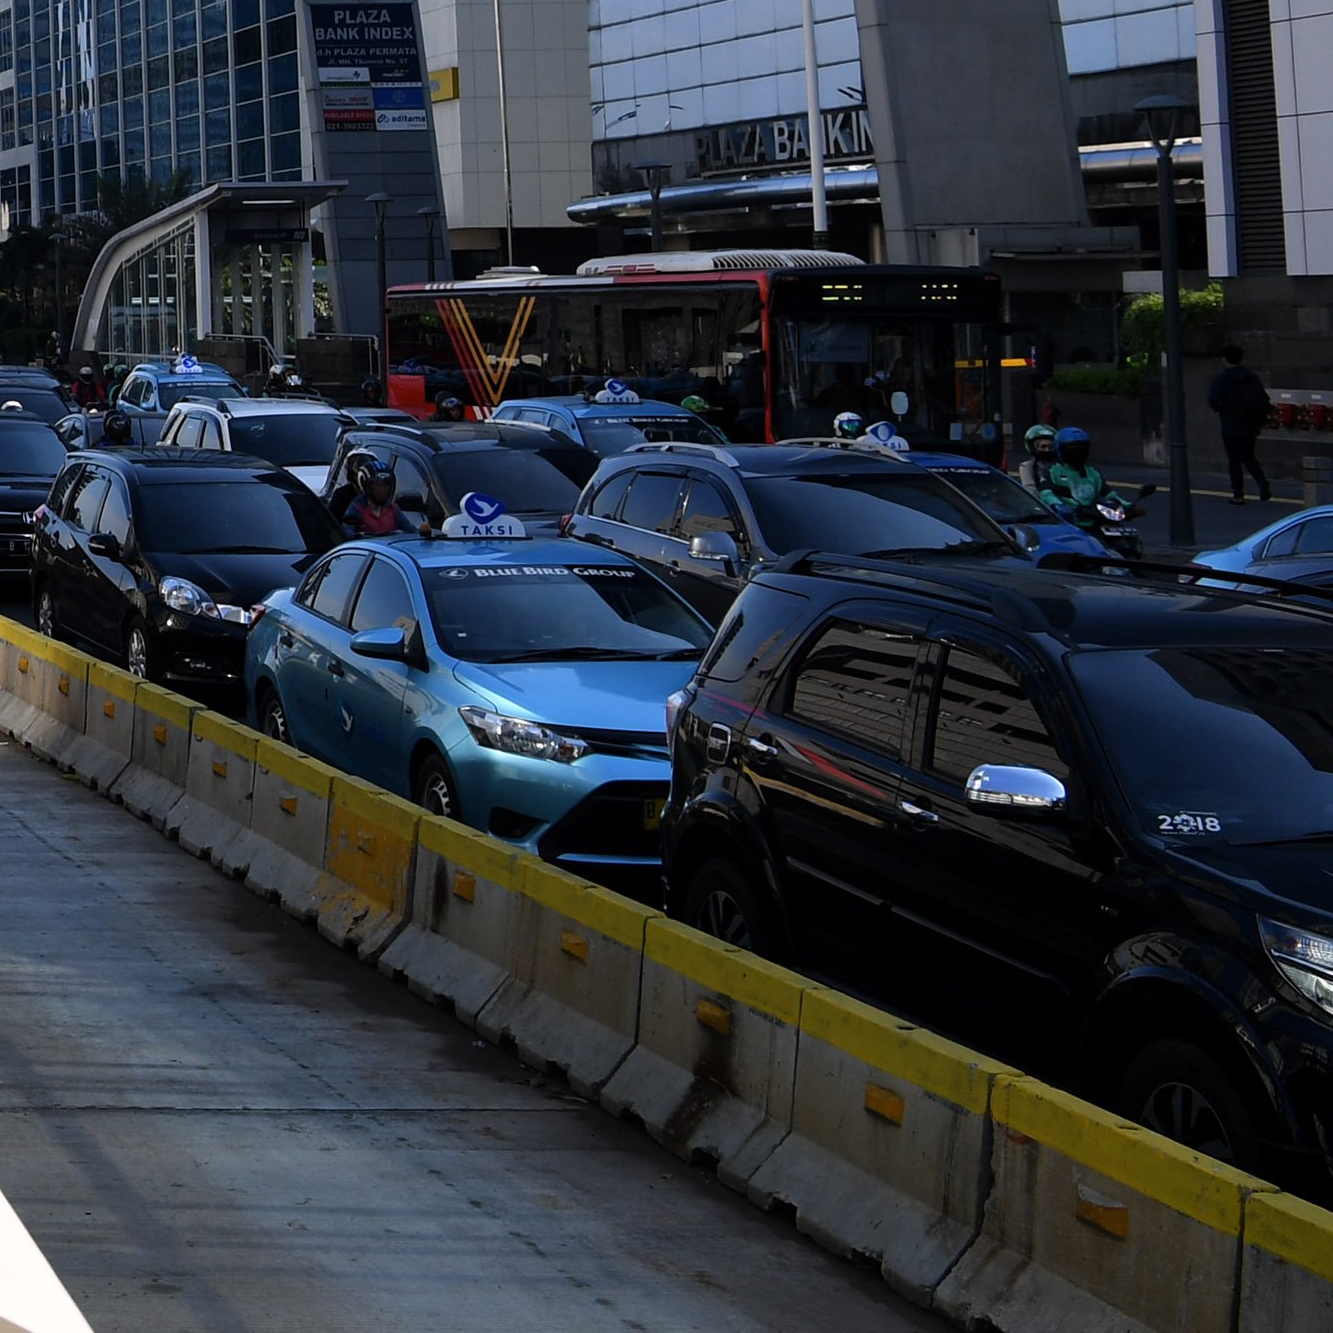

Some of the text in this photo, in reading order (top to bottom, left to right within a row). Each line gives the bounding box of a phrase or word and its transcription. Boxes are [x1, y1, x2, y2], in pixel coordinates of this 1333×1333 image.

[334, 9, 391, 24] PLAZA
[315, 26, 414, 41] BANK INDEX
[333, 47, 366, 57] PLAZA
[369, 47, 418, 56] PERMATA
[391, 114, 426, 123] aditama
[696, 123, 770, 166] PLAZA
[461, 525, 513, 535] TAKSI
[647, 801, 655, 819] B
